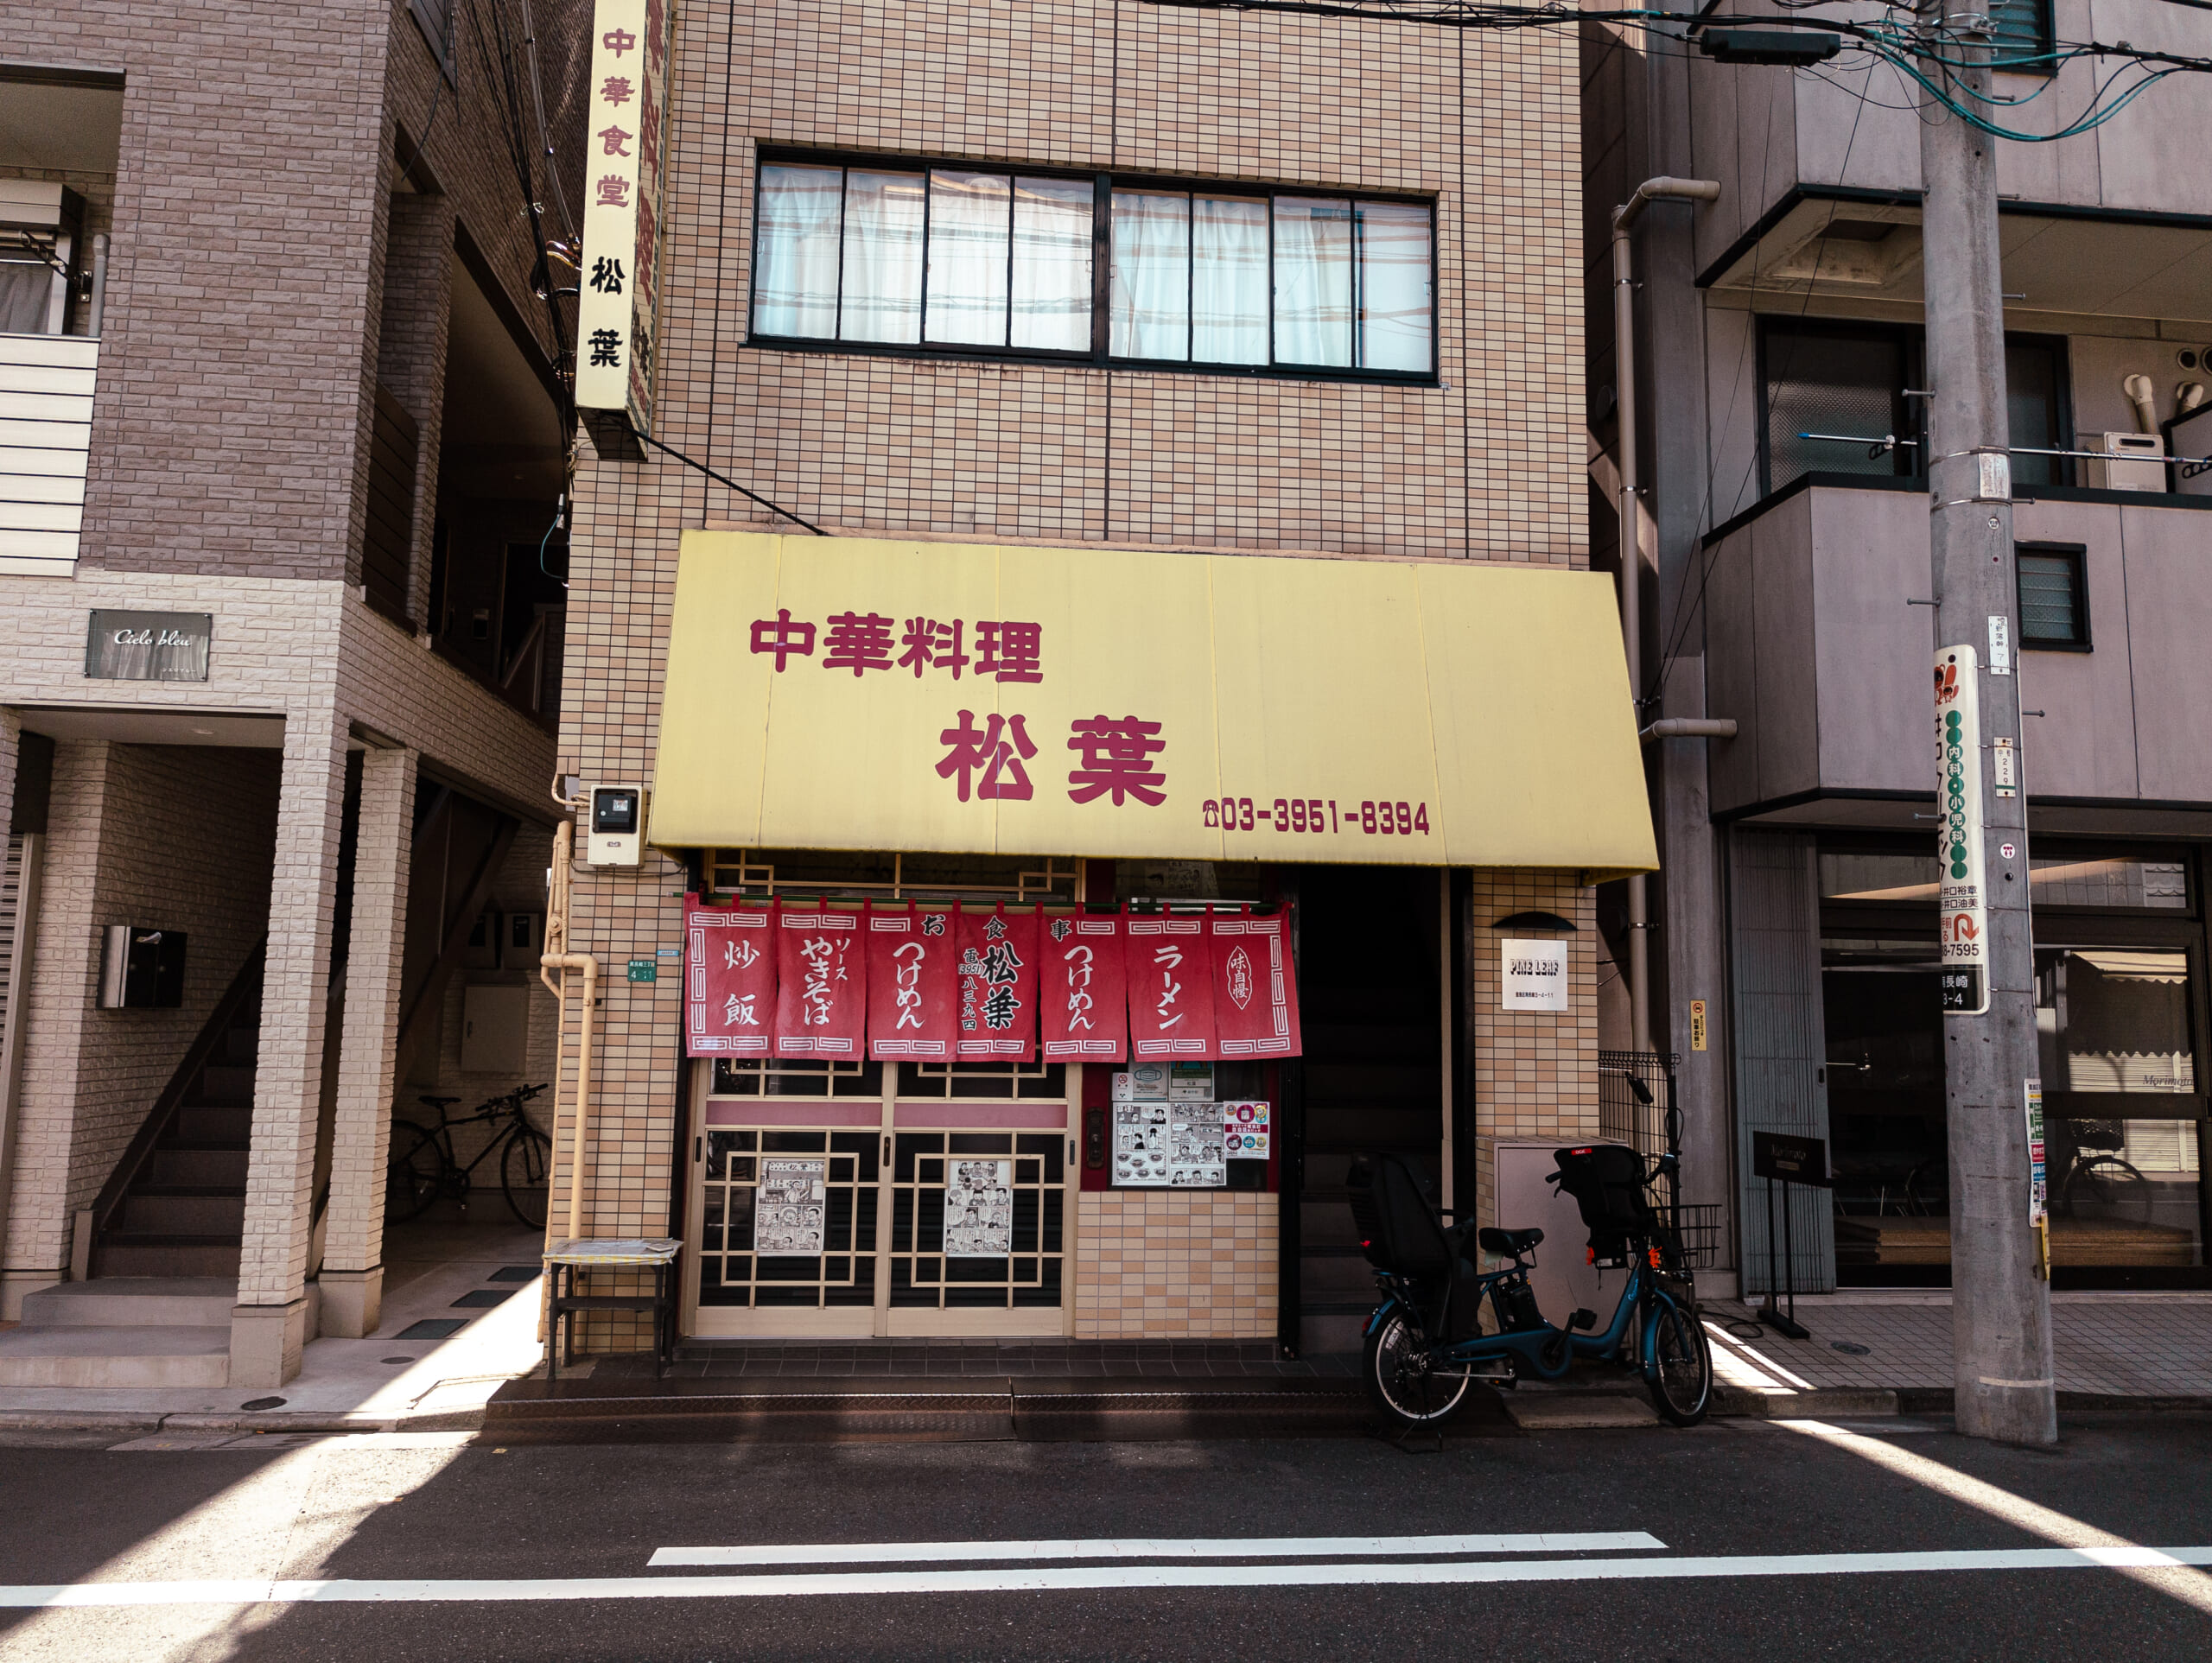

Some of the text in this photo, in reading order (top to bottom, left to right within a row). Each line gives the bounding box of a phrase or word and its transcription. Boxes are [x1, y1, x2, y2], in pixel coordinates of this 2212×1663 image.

[596, 28, 636, 207] 中華食堂
[588, 256, 626, 369] 松葉
[114, 628, 191, 647] Cielo bleu
[750, 608, 1043, 683] 中華料理
[935, 709, 1167, 807] 松葉
[1221, 797, 1430, 835] 03-3951-8394
[723, 940, 760, 1026] 炒飯
[800, 936, 834, 1026] やきそば
[835, 937, 851, 981] ソース
[893, 942, 926, 1031] つけめん
[980, 940, 1024, 1031] 松葉
[1064, 945, 1096, 1032] つけめん
[1154, 945, 1184, 1031] ラーメン
[1230, 953, 1249, 1000] 味自慢
[1510, 958, 1534, 976] PINE
